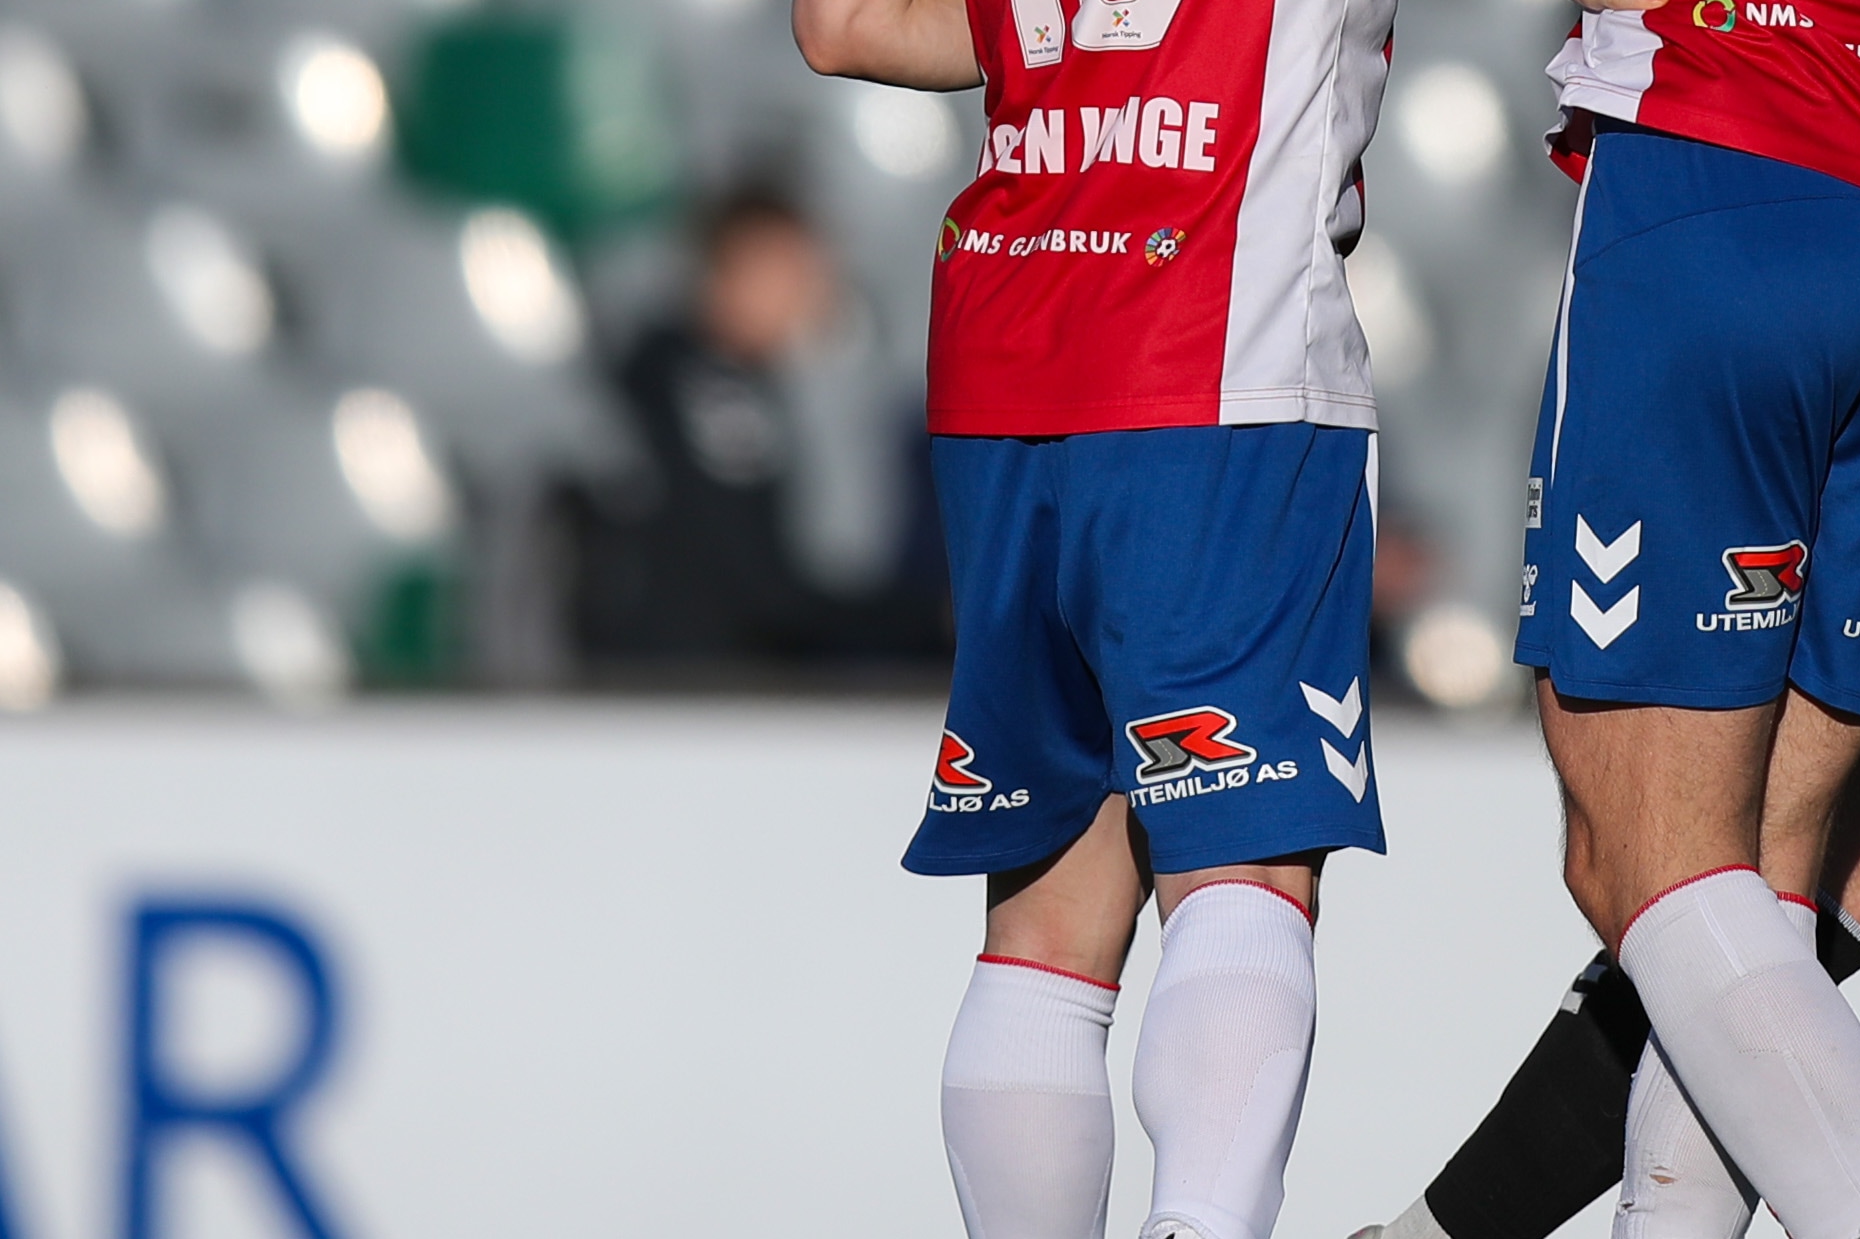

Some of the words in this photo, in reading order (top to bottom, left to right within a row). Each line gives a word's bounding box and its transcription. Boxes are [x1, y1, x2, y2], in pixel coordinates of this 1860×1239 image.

[1256, 761, 1299, 783] AS
[989, 788, 1031, 812] AS
[0, 890, 365, 1239] R
